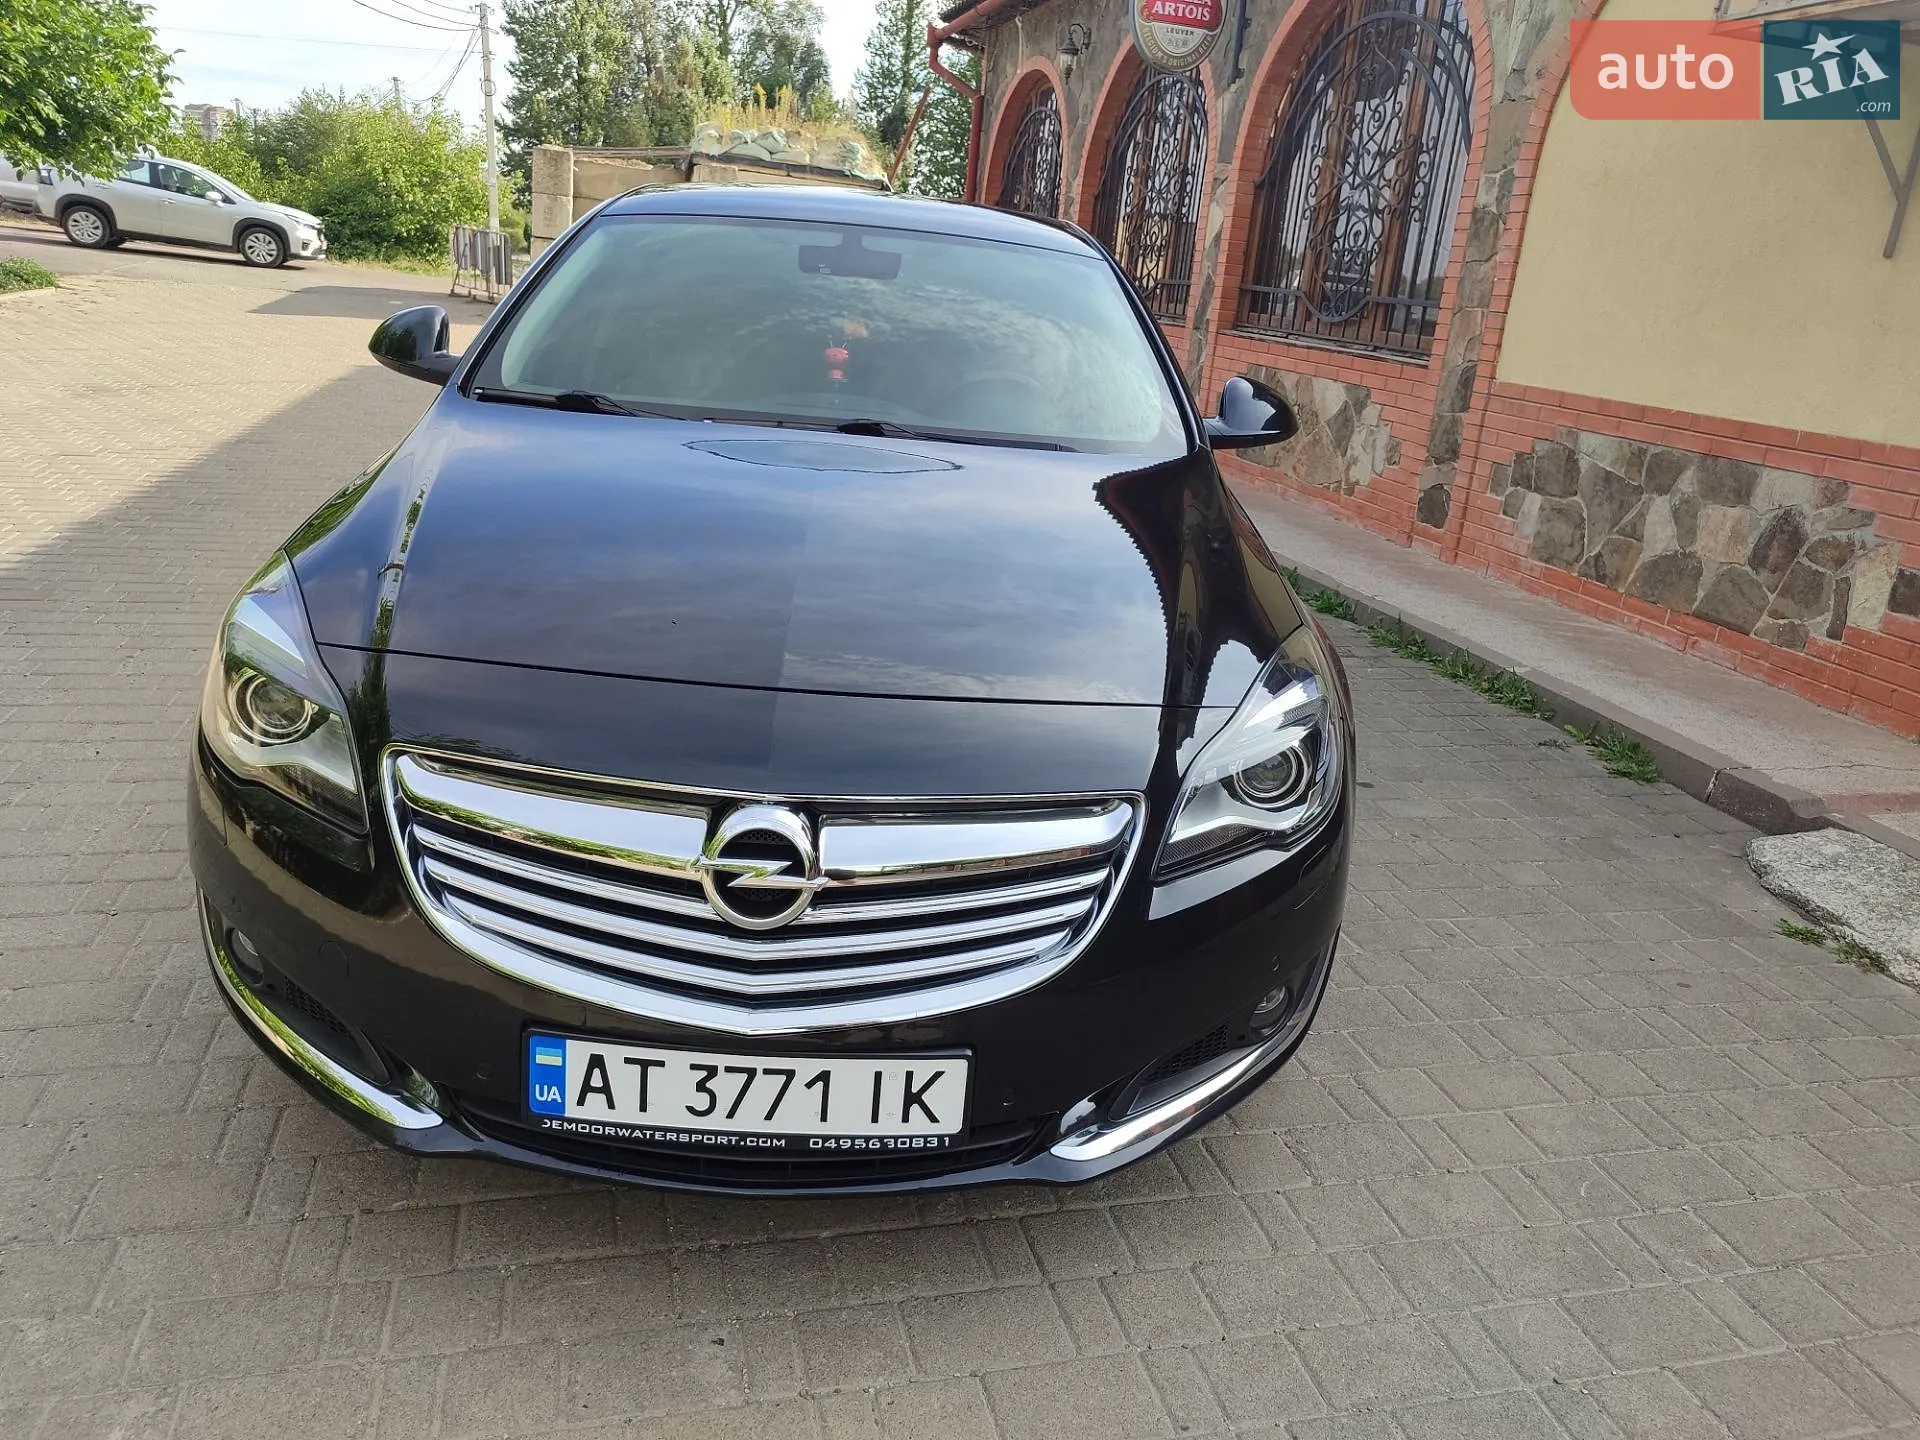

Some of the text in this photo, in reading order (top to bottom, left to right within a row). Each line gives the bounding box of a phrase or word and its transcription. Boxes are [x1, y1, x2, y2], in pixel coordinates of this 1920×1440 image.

[1152, 1, 1211, 21] ARTOIS
[1165, 27, 1195, 37] LEUVEN
[535, 1086, 562, 1103] UA
[576, 1053, 947, 1124] AT 3771 IK
[809, 1136, 949, 1149] 0495630831
